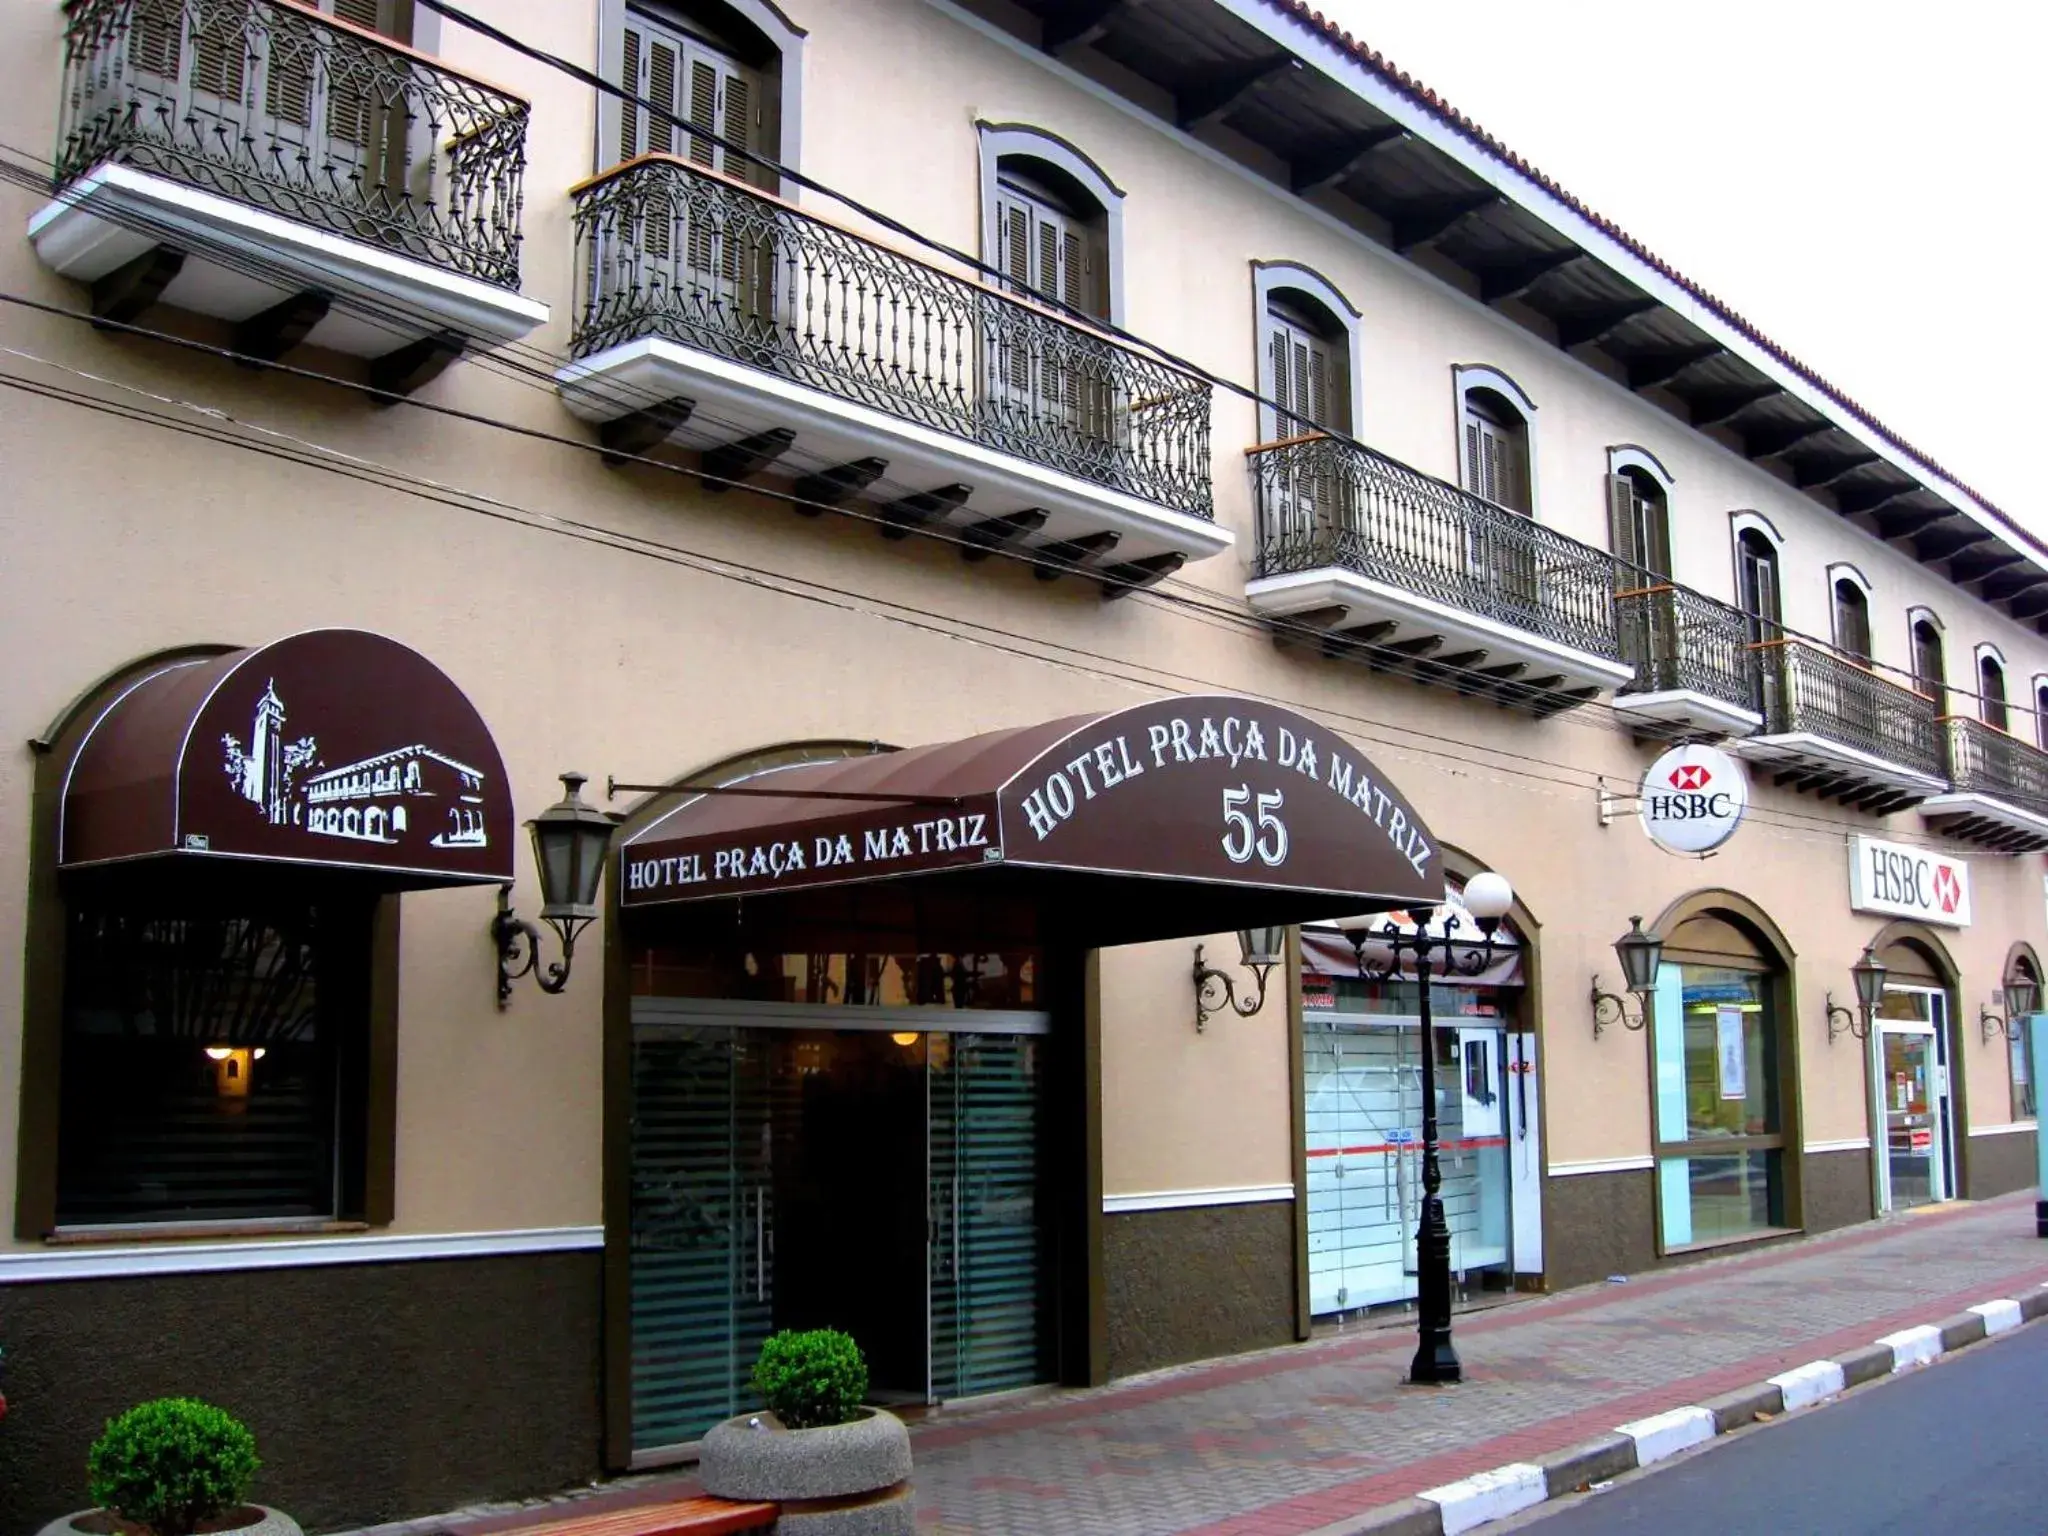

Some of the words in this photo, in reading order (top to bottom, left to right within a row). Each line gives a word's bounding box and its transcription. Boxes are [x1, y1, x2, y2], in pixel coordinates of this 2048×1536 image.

[1021, 736, 1145, 842] HOTEL
[1148, 716, 1268, 769] PRAÇA
[1278, 726, 1320, 781] DA
[1327, 752, 1432, 880] MATRIZ
[1221, 783, 1288, 867] 55
[1650, 792, 1731, 821] HSBC
[629, 855, 707, 890] HOTEL
[714, 841, 806, 879] PRAÇA
[815, 834, 855, 868] DA
[863, 814, 989, 861] MATRIZ
[1870, 846, 1932, 909] HSBC
